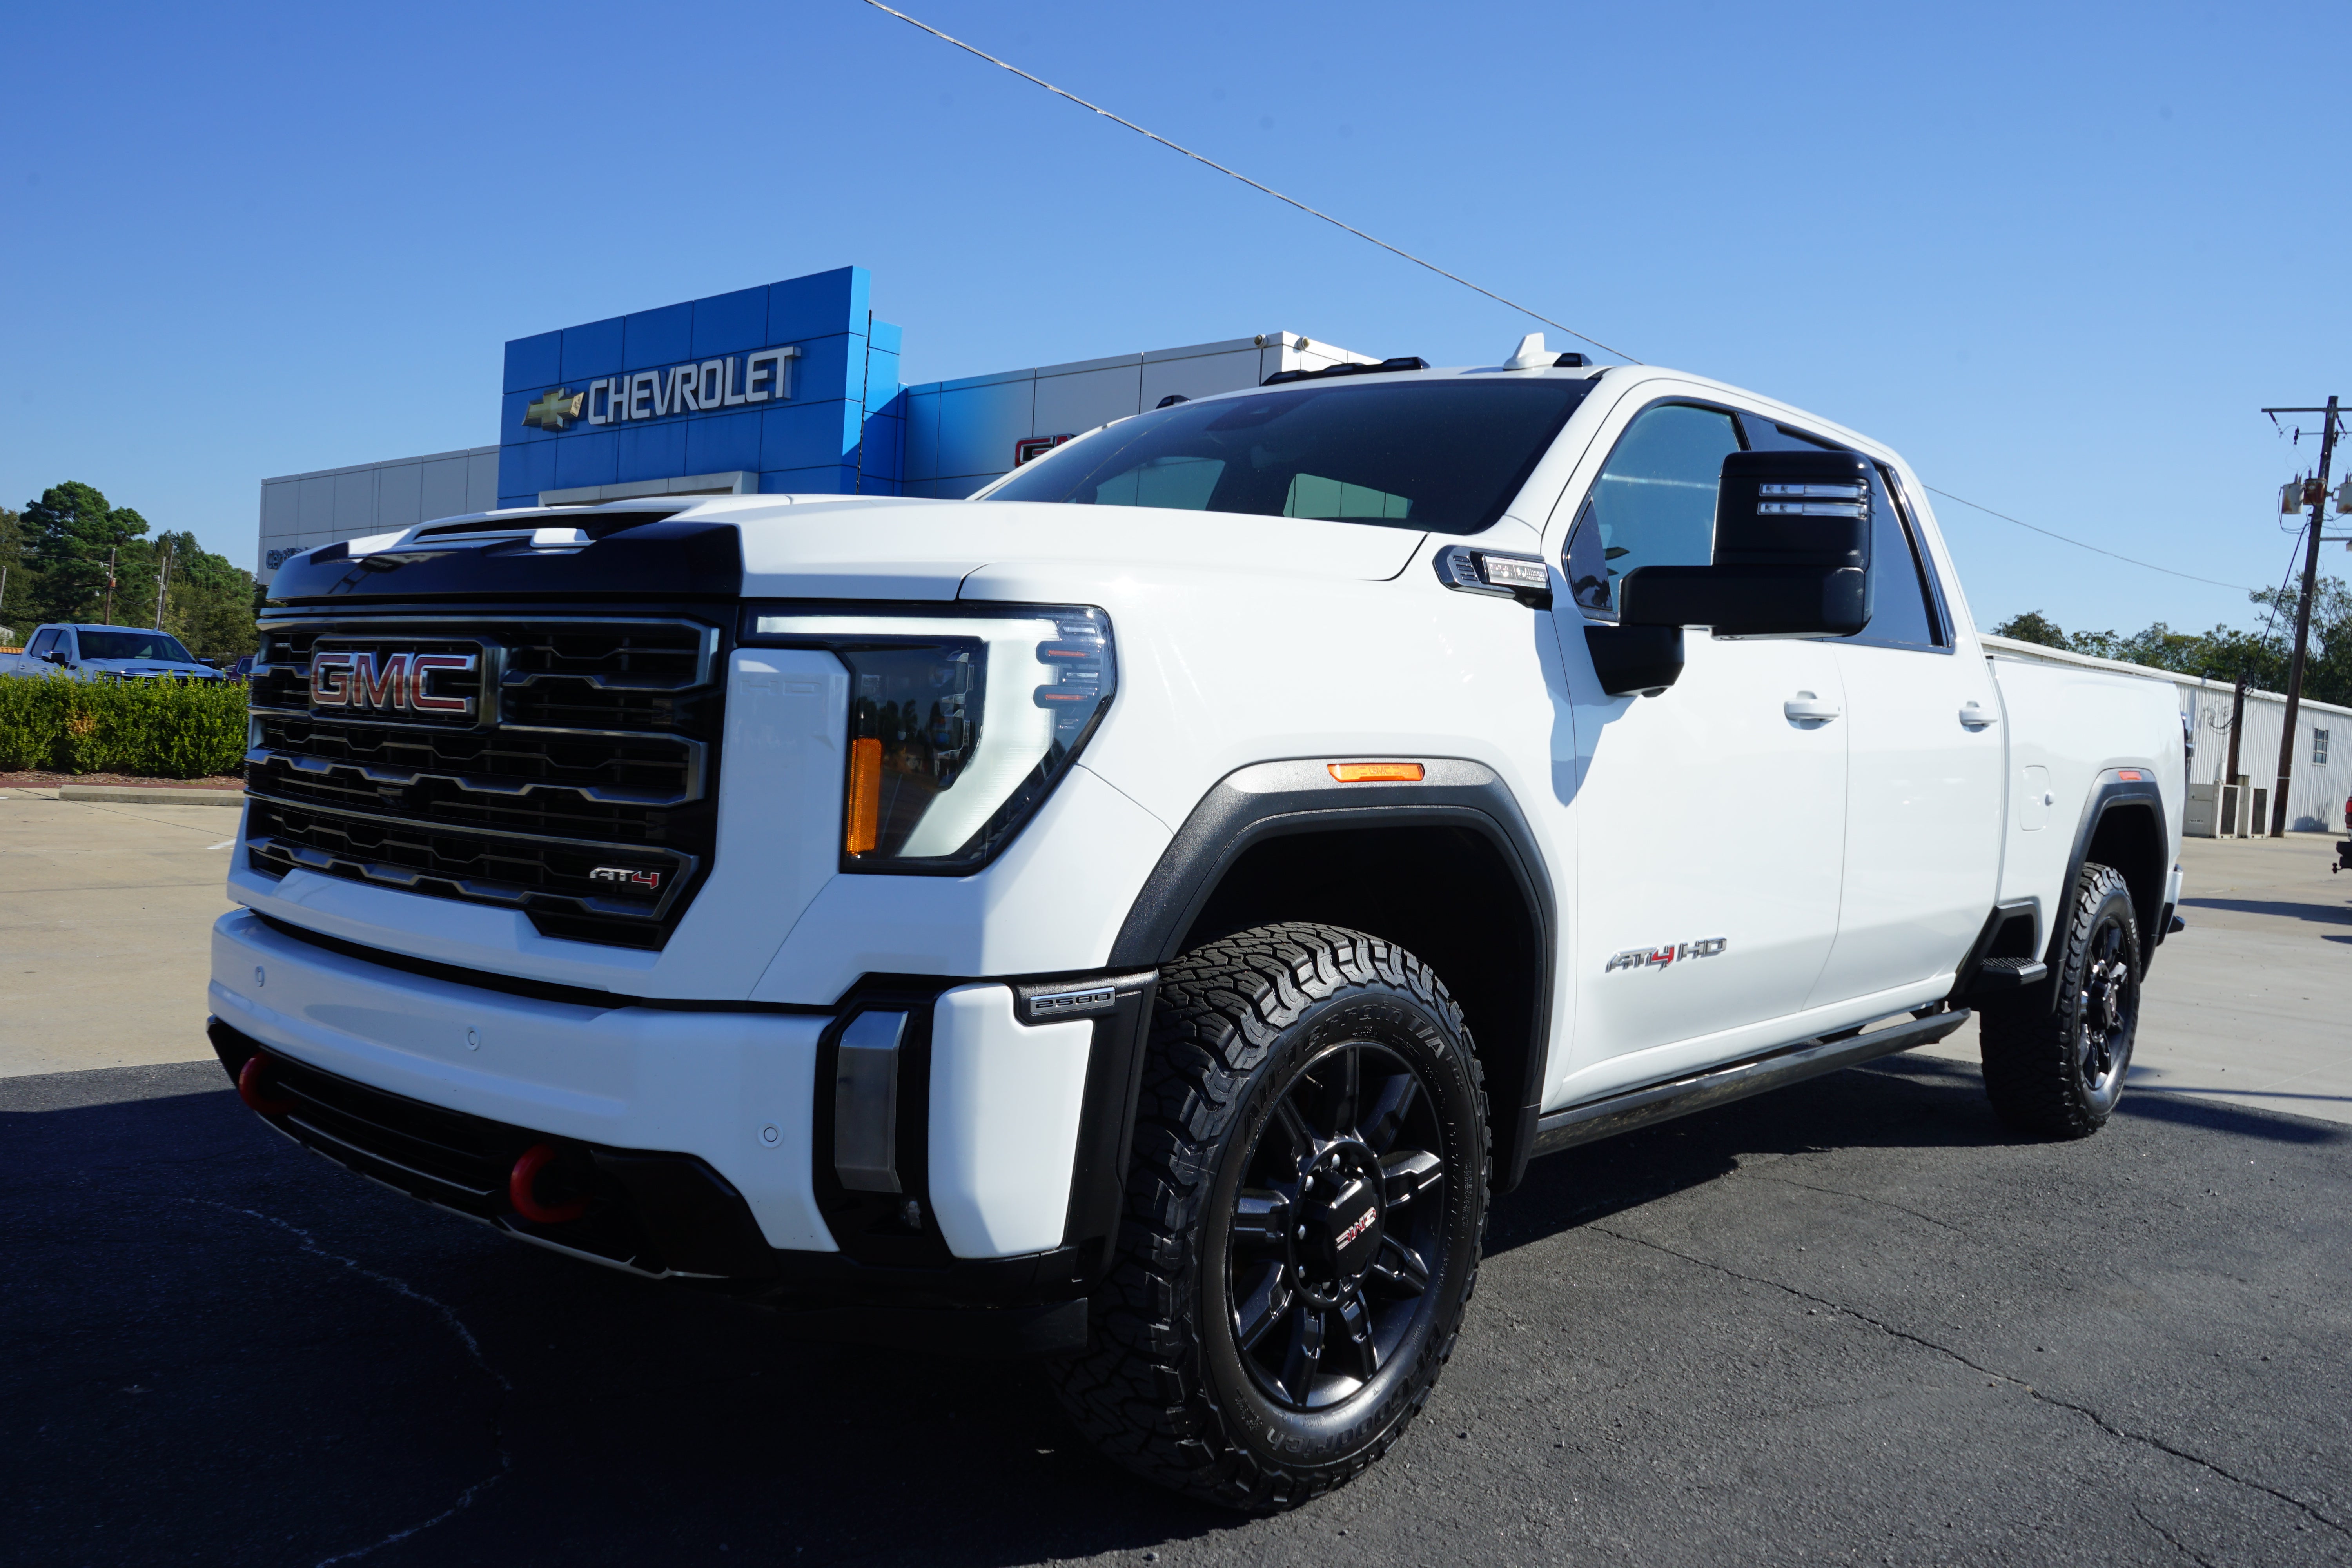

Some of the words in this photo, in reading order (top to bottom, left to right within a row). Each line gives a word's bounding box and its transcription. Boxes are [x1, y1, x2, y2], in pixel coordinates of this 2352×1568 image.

[588, 346, 801, 426] CHEVROLET
[311, 651, 478, 715] GMC
[740, 680, 822, 696] HD
[1368, 767, 1392, 775] GMC
[589, 867, 661, 890] AT4
[1605, 944, 1675, 973] AT4
[1676, 936, 1727, 962] HD
[1035, 993, 1111, 1009] 2500
[1335, 1207, 1376, 1251] GMC
